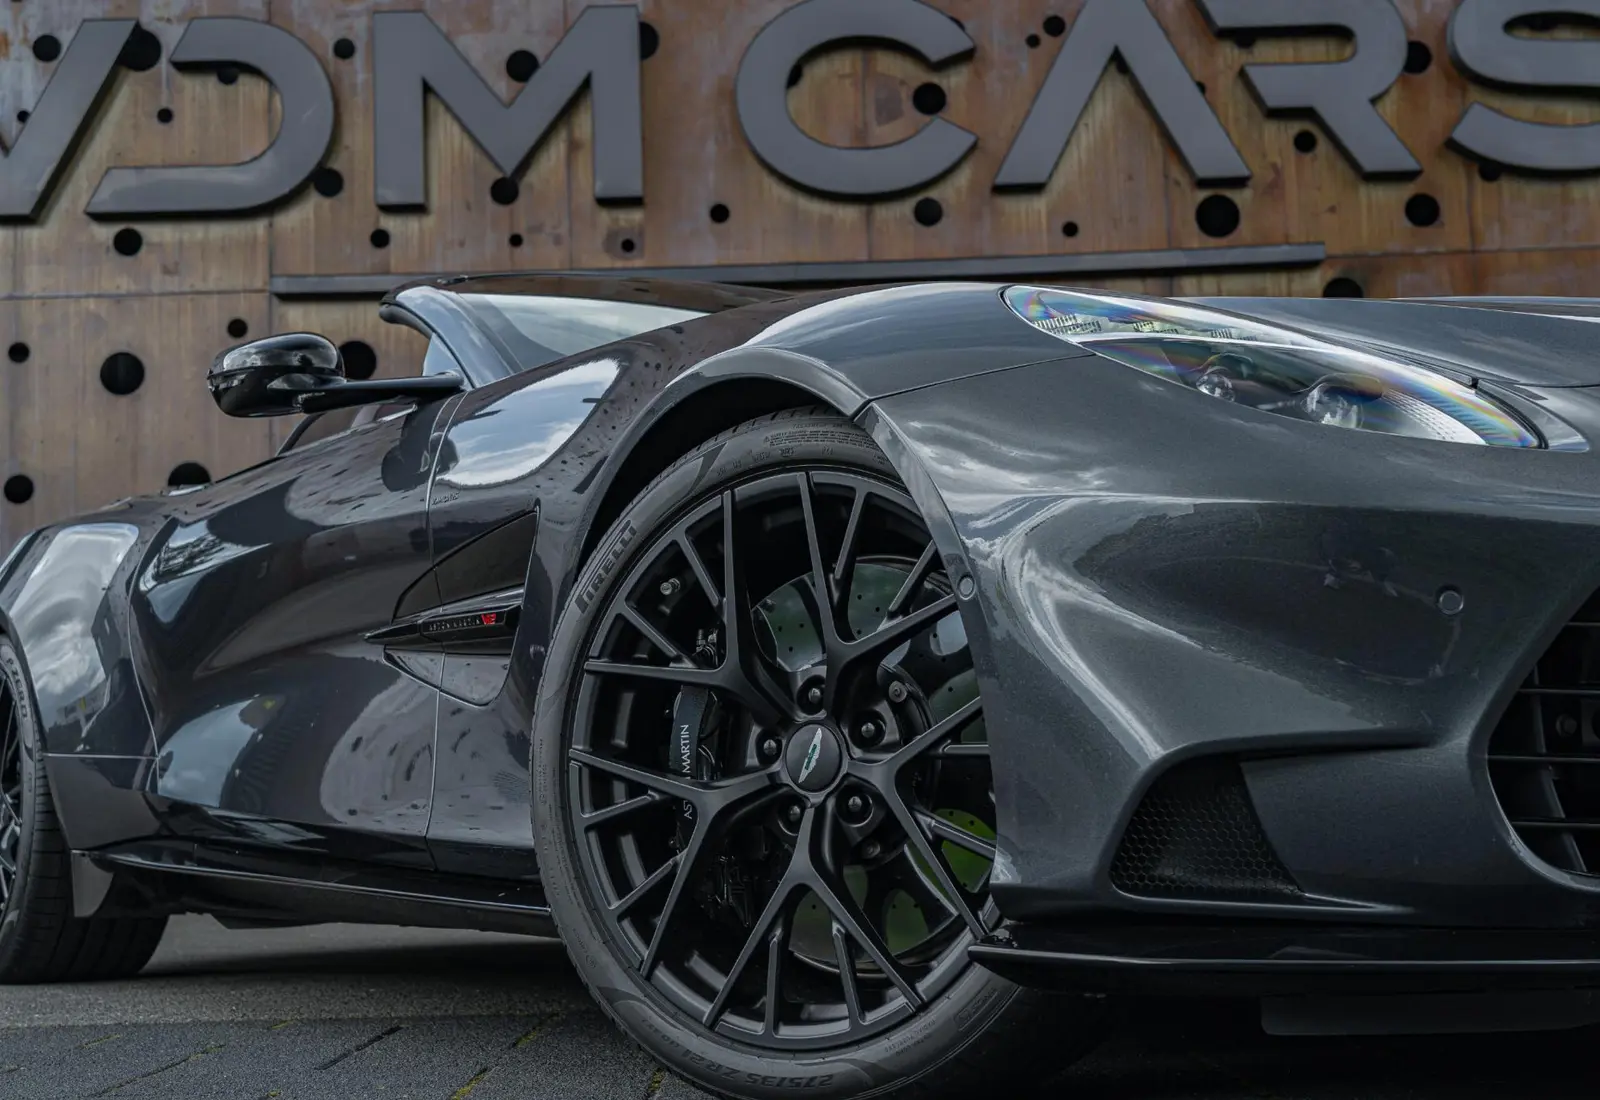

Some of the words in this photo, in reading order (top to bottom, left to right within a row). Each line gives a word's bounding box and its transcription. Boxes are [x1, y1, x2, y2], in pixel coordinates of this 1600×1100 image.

[0, 5, 645, 221] VDM
[736, 0, 1600, 196] CARS
[574, 519, 638, 614] PIRELLI
[680, 724, 692, 773] MARTIN
[746, 1073, 834, 1089] 275/35
